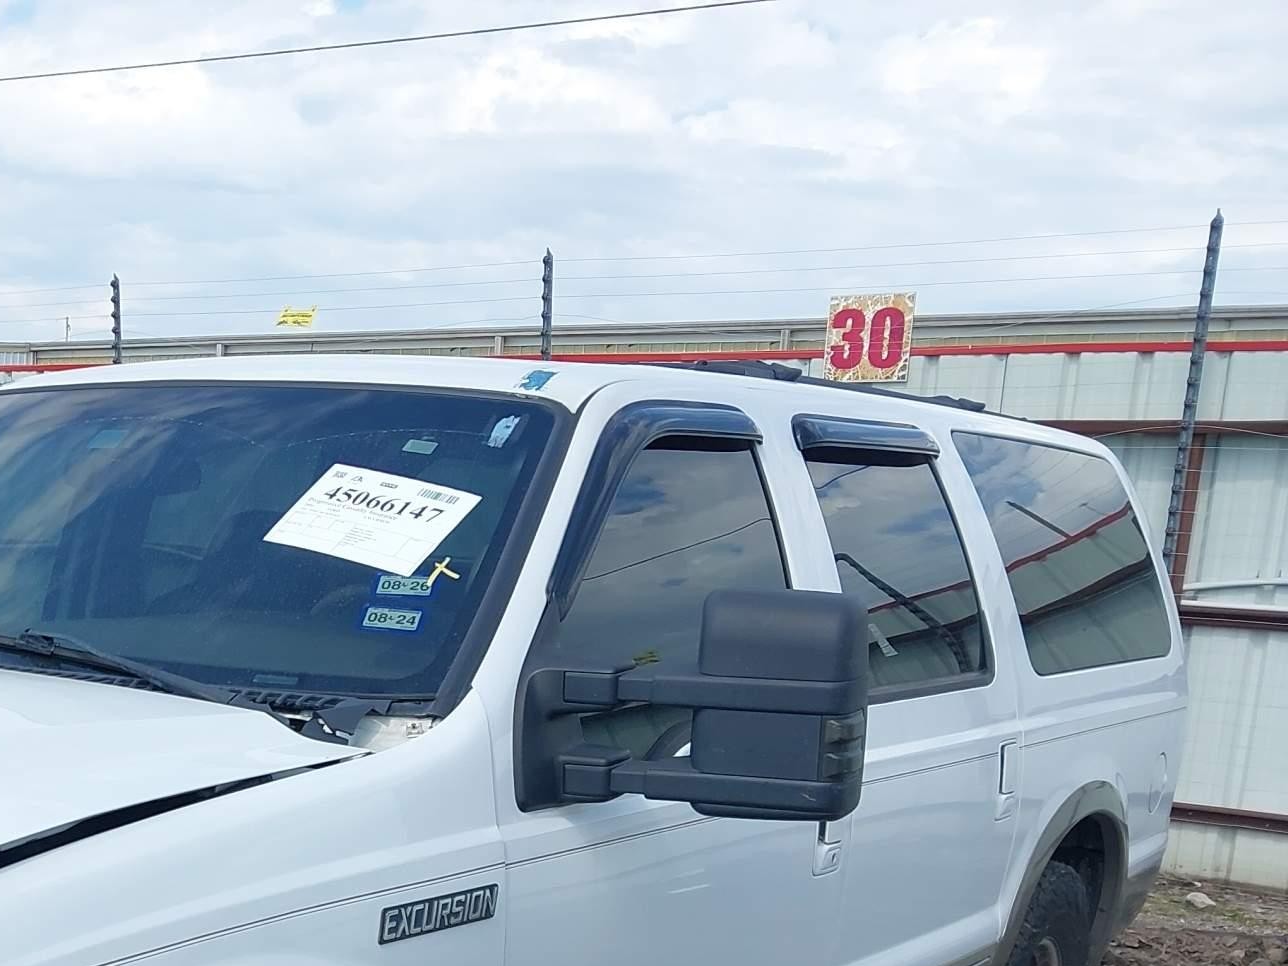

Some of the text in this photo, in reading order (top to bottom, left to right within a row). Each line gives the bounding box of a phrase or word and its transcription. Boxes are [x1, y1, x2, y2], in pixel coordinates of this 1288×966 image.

[829, 306, 906, 370] 30
[323, 486, 445, 523] 45066147
[382, 886, 498, 942] EXCURSION
